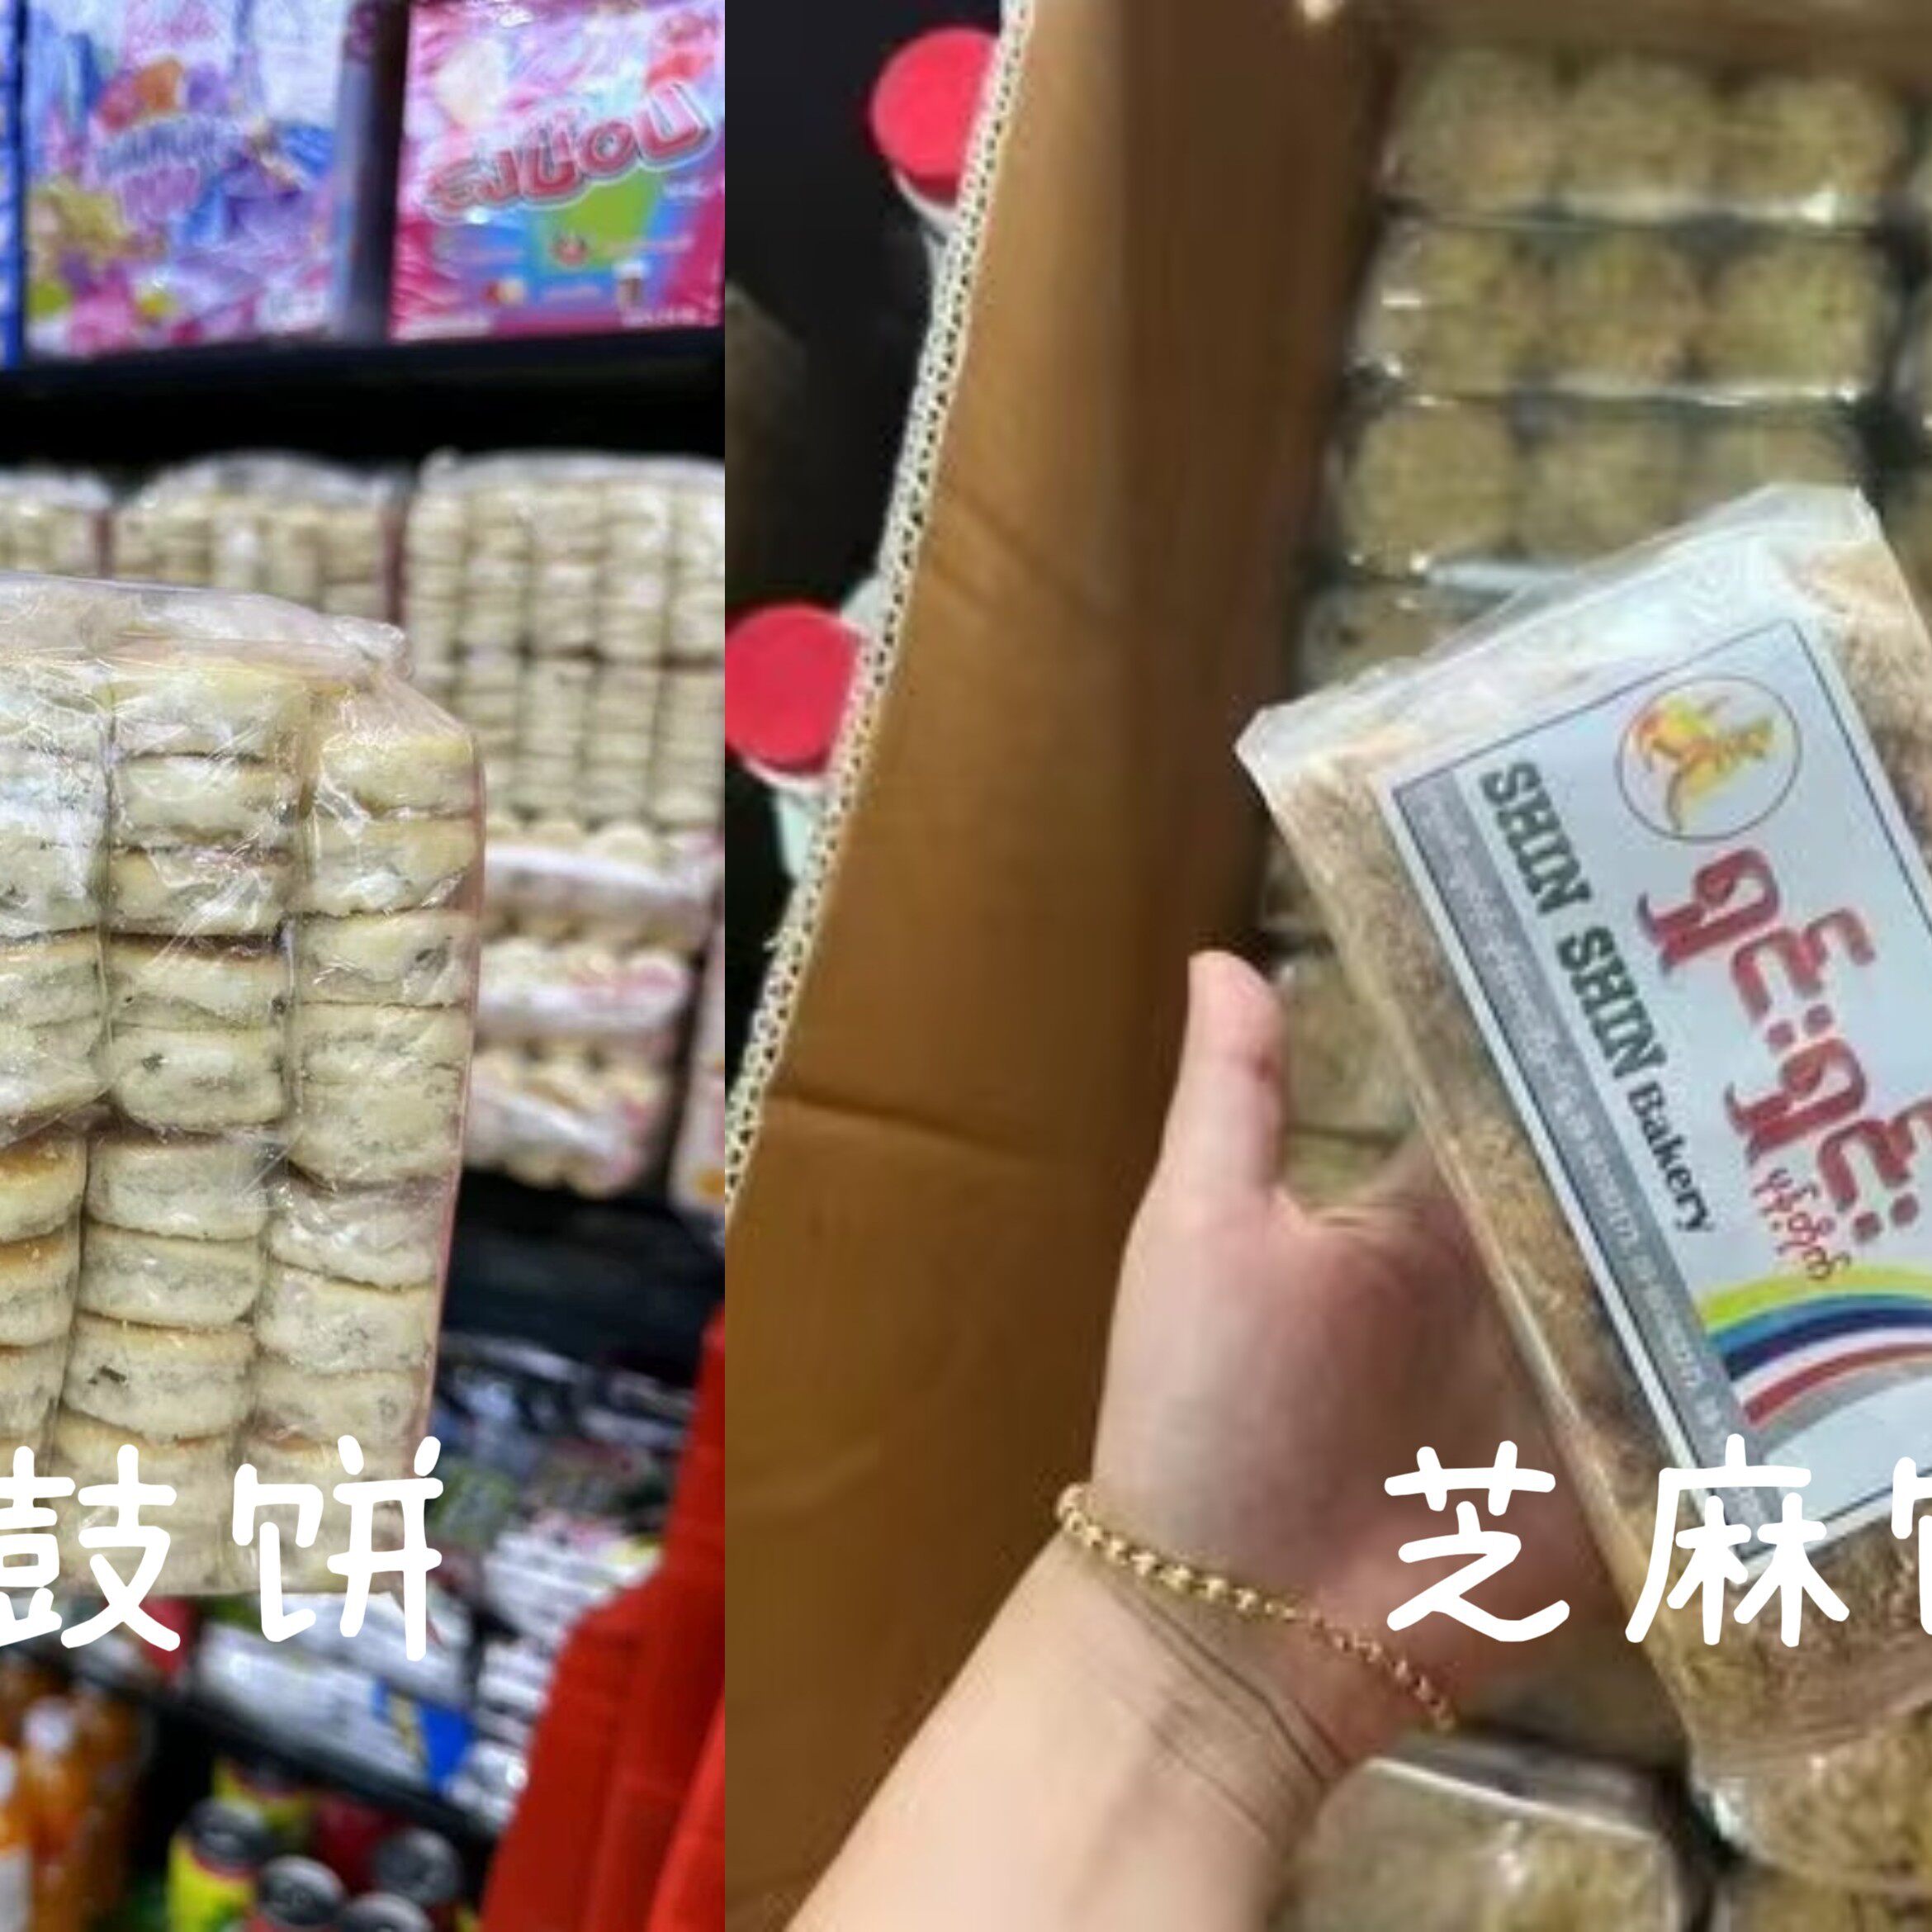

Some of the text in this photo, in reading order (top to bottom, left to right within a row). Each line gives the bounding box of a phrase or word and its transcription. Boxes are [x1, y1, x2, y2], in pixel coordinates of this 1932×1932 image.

[1480, 761, 1591, 917] SHIN
[1556, 926, 1666, 1080] SHIN
[1627, 1081, 1714, 1233] Bakery
